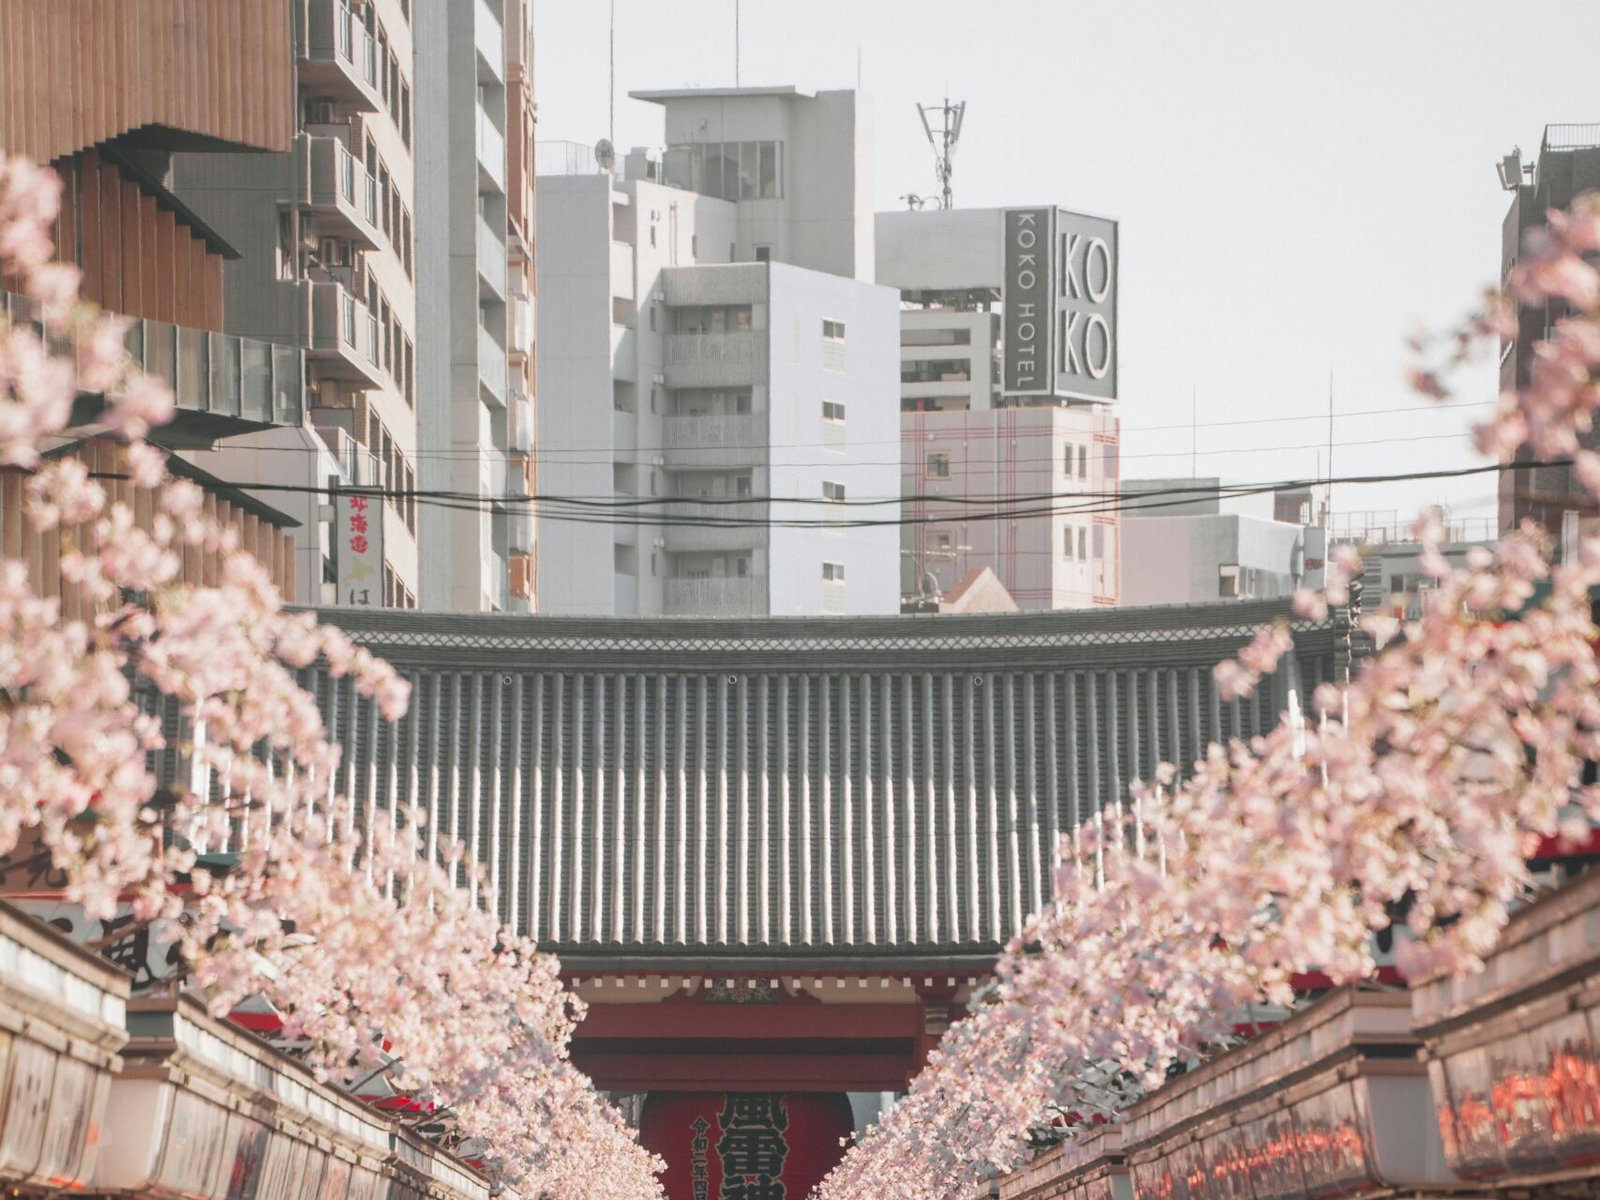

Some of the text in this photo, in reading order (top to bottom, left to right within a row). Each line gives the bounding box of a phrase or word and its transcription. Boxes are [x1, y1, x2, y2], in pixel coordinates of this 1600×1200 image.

[1017, 213, 1036, 388] KOKO HOTEL
[1061, 232, 1112, 304] KO
[1060, 309, 1112, 380] KO
[350, 495, 369, 554] 北海道
